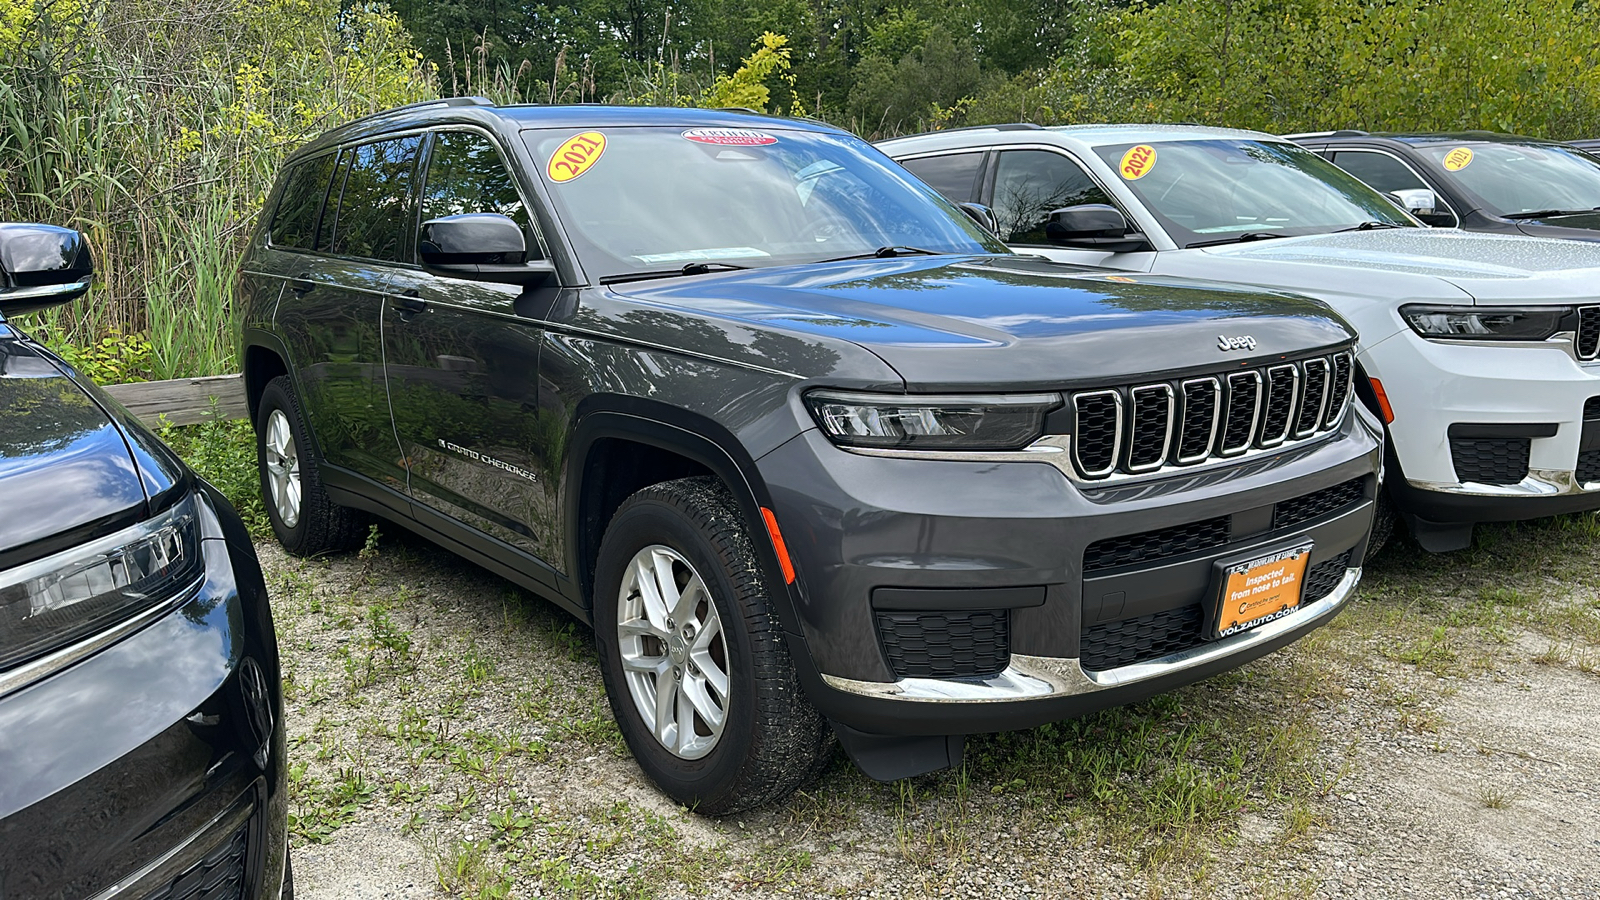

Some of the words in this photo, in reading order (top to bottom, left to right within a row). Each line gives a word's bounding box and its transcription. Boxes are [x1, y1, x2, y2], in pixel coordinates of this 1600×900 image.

[555, 136, 601, 176] 2021
[1124, 146, 1152, 177] 2022
[1447, 149, 1470, 168] 2021
[1217, 334, 1257, 351] Jeep
[447, 442, 480, 460] GRAND
[481, 454, 537, 483] CHEROKEE
[1231, 589, 1250, 601] from
[1252, 582, 1271, 595] nose
[1272, 579, 1280, 588] to
[1282, 573, 1295, 585] tail.
[1246, 566, 1284, 587] Inspected
[1219, 605, 1300, 638] VOLZAUTO.COM
